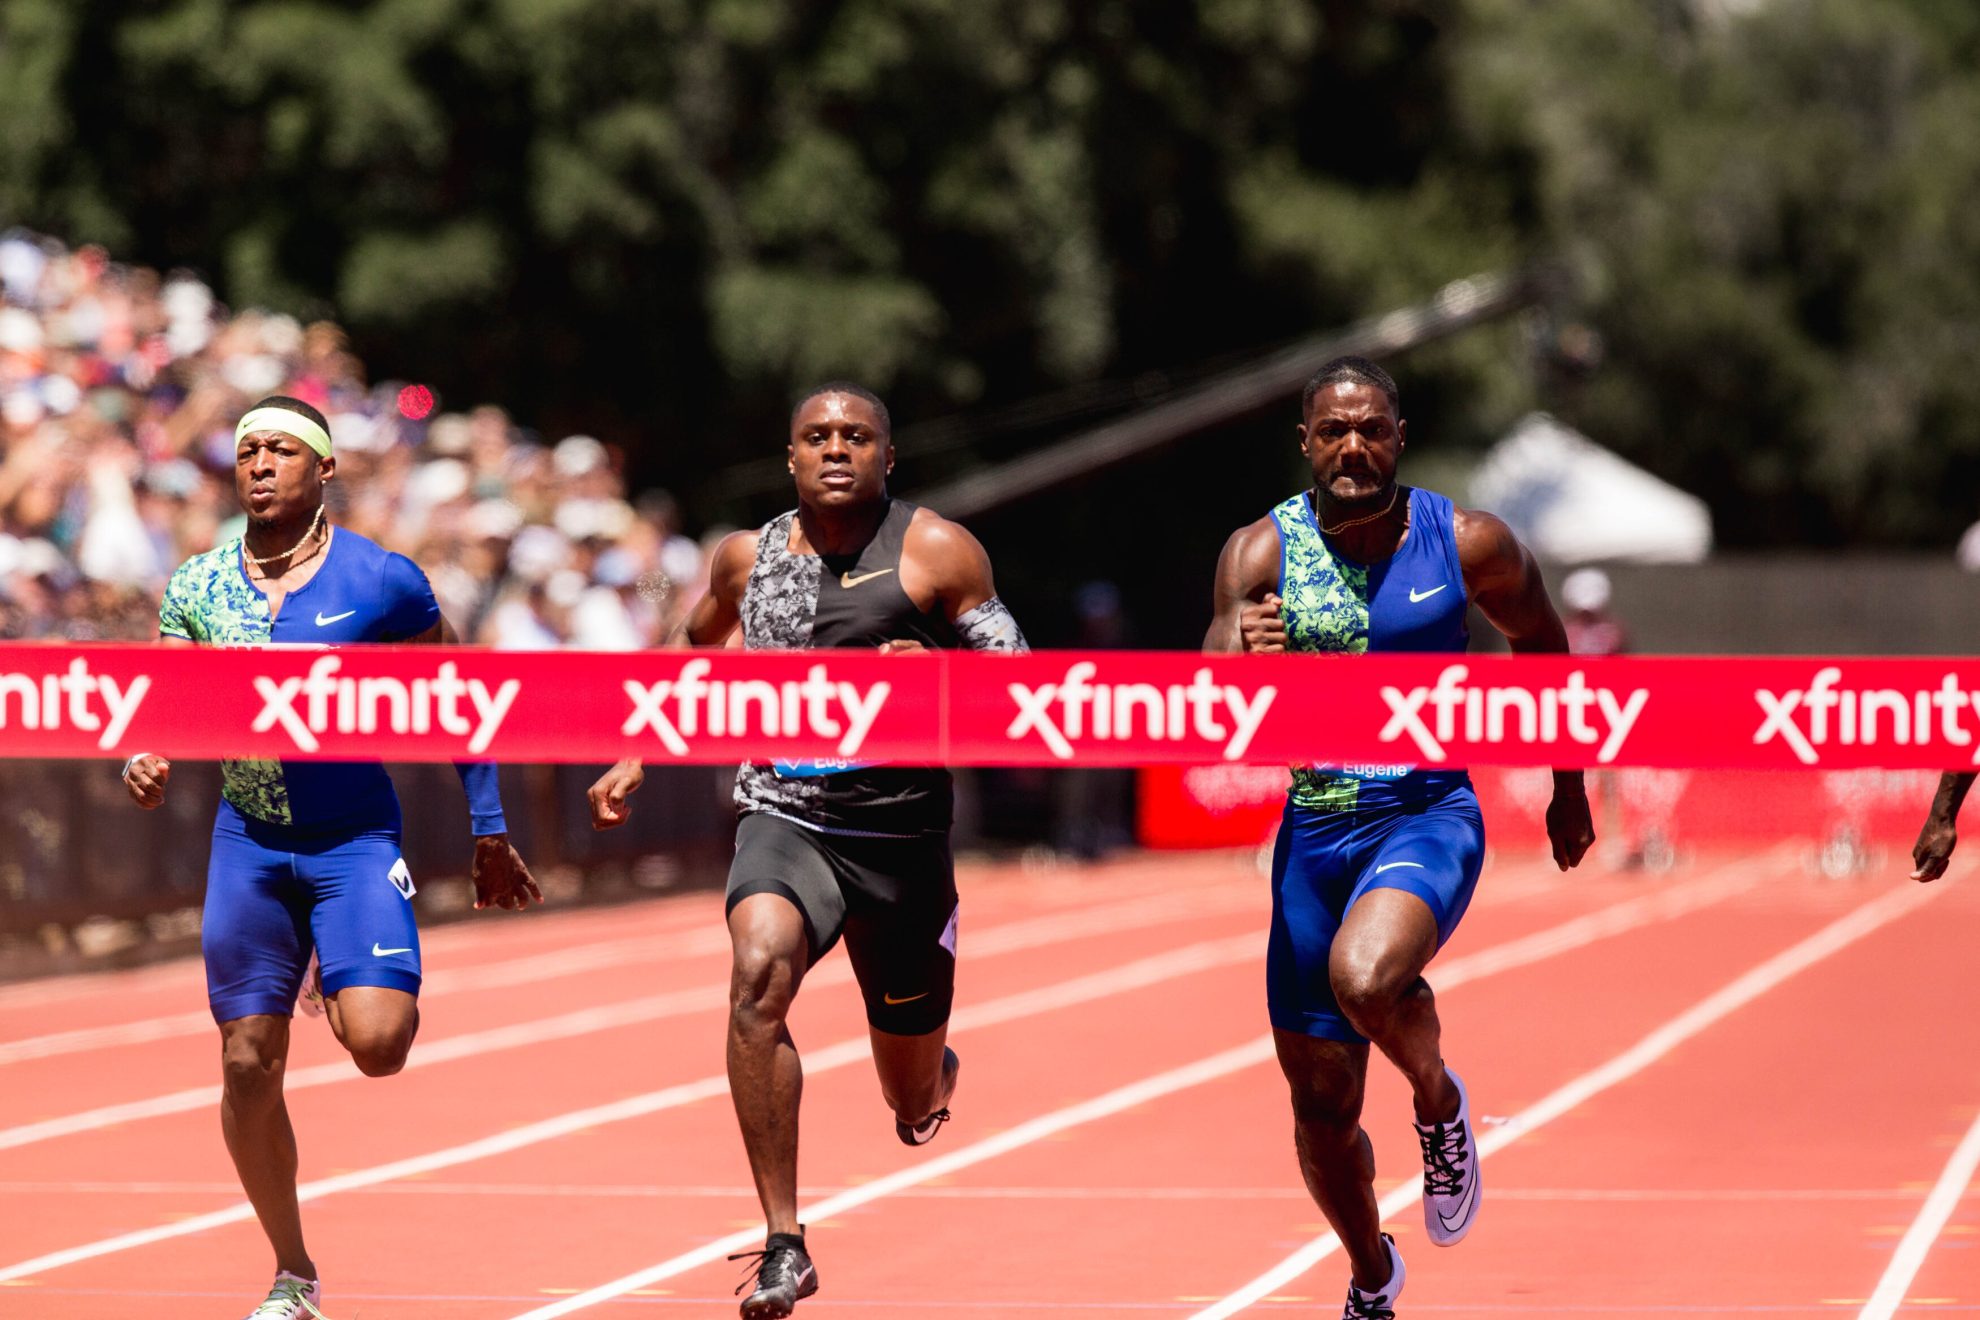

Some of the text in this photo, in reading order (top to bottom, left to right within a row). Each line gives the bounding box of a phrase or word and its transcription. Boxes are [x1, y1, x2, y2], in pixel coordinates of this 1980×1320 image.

[251, 655, 520, 754] xfinity
[621, 658, 891, 757] xfinity
[1006, 661, 1277, 760] xfinity
[1378, 664, 1650, 763] xfinity
[1753, 667, 1980, 765] xfinit
[1342, 761, 1408, 779] Eugene
